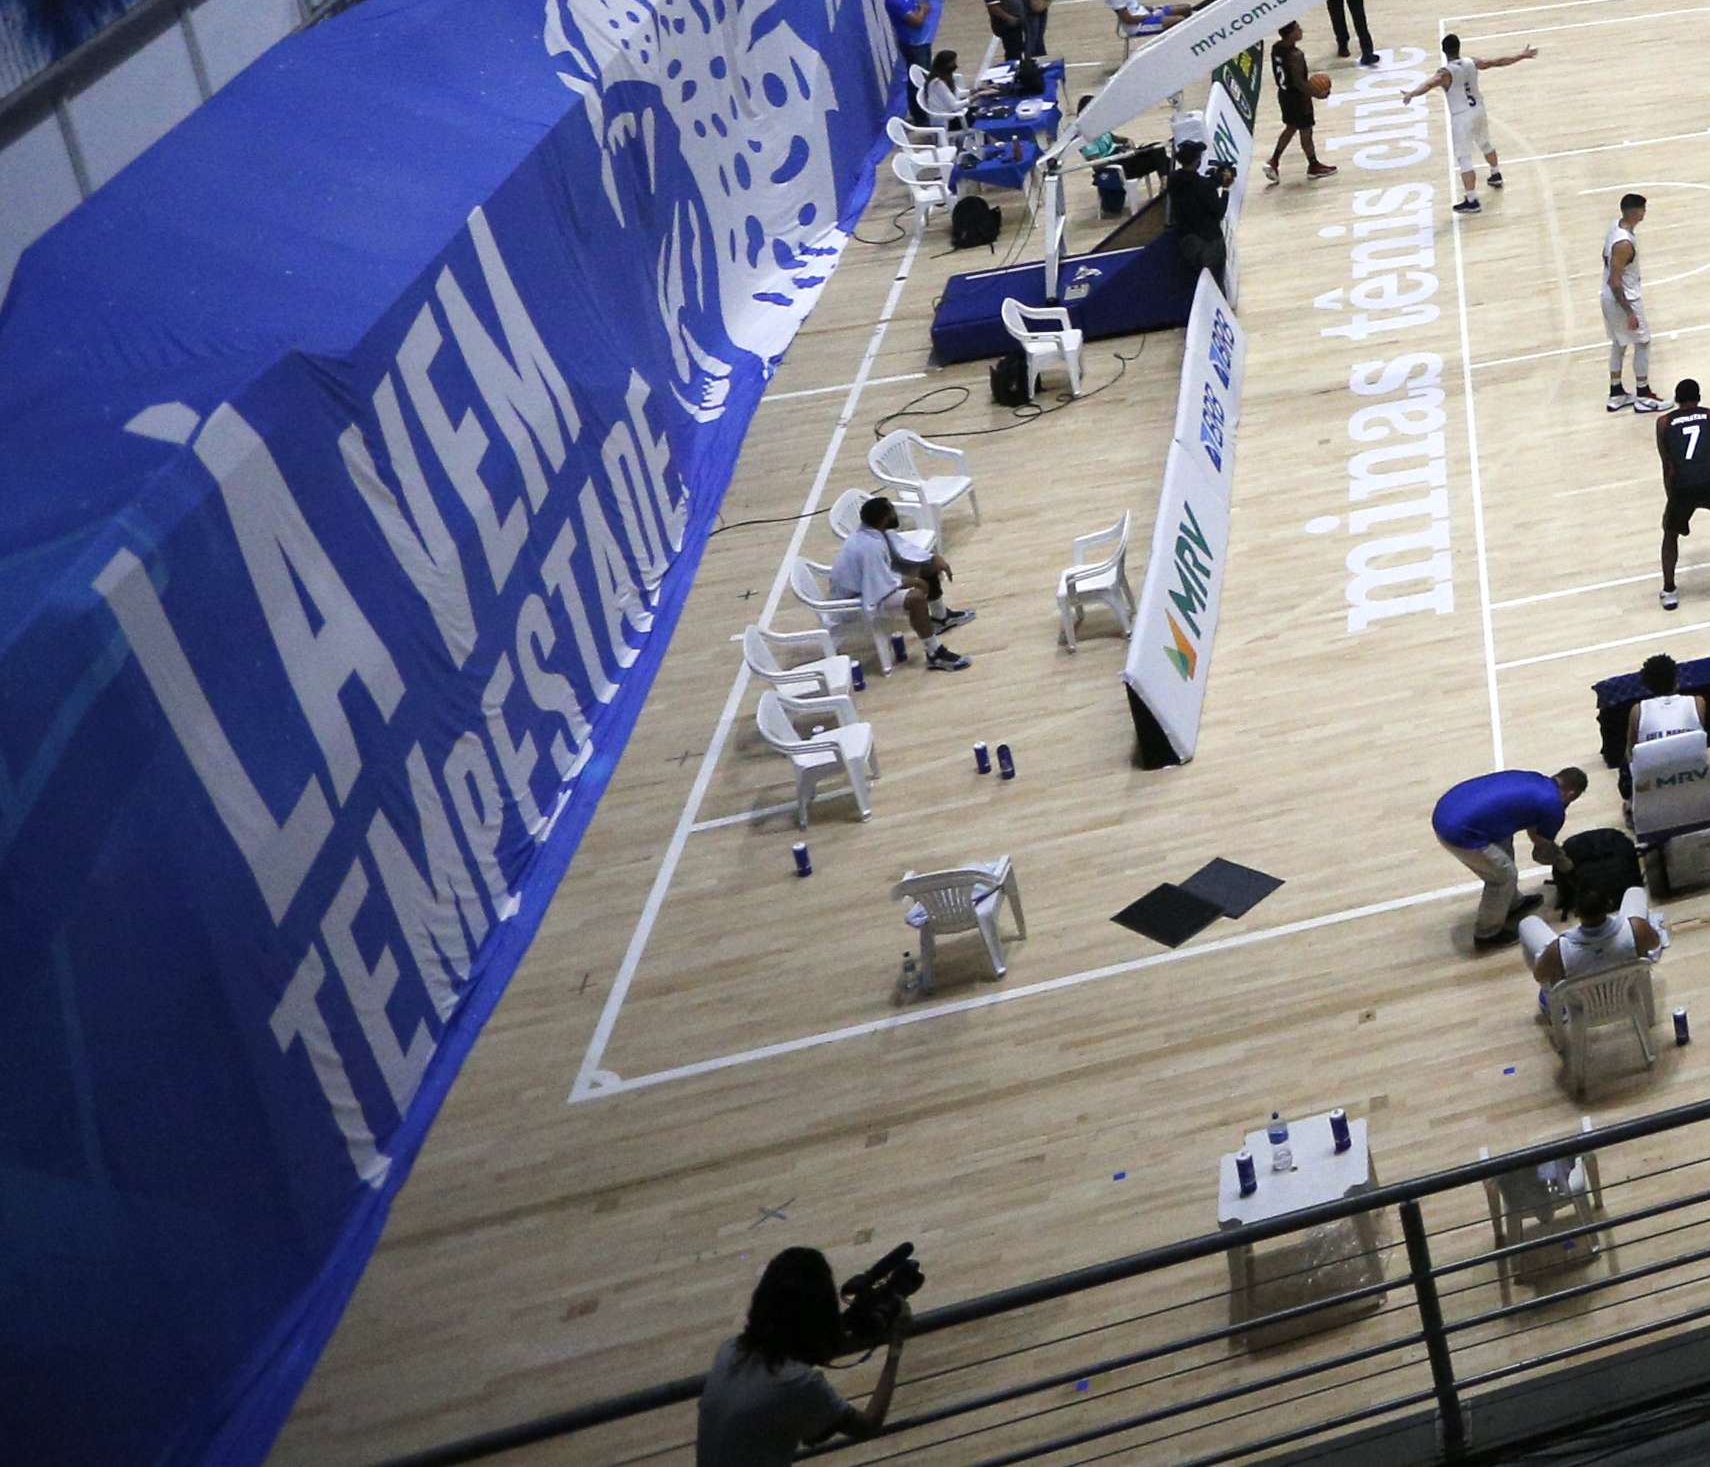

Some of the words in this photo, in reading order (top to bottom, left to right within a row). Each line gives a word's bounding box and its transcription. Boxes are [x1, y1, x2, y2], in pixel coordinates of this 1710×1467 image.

[1213, 110, 1240, 165] RV
[1326, 45, 1432, 171] clube
[1314, 181, 1441, 342] tênis
[338, 204, 584, 670] VEM
[1305, 351, 1453, 632] minas
[1682, 425, 1700, 459] 7
[1167, 500, 1215, 640] MRV
[268, 367, 690, 1190] TEMPESTADE
[1655, 766, 1709, 789] MRV
